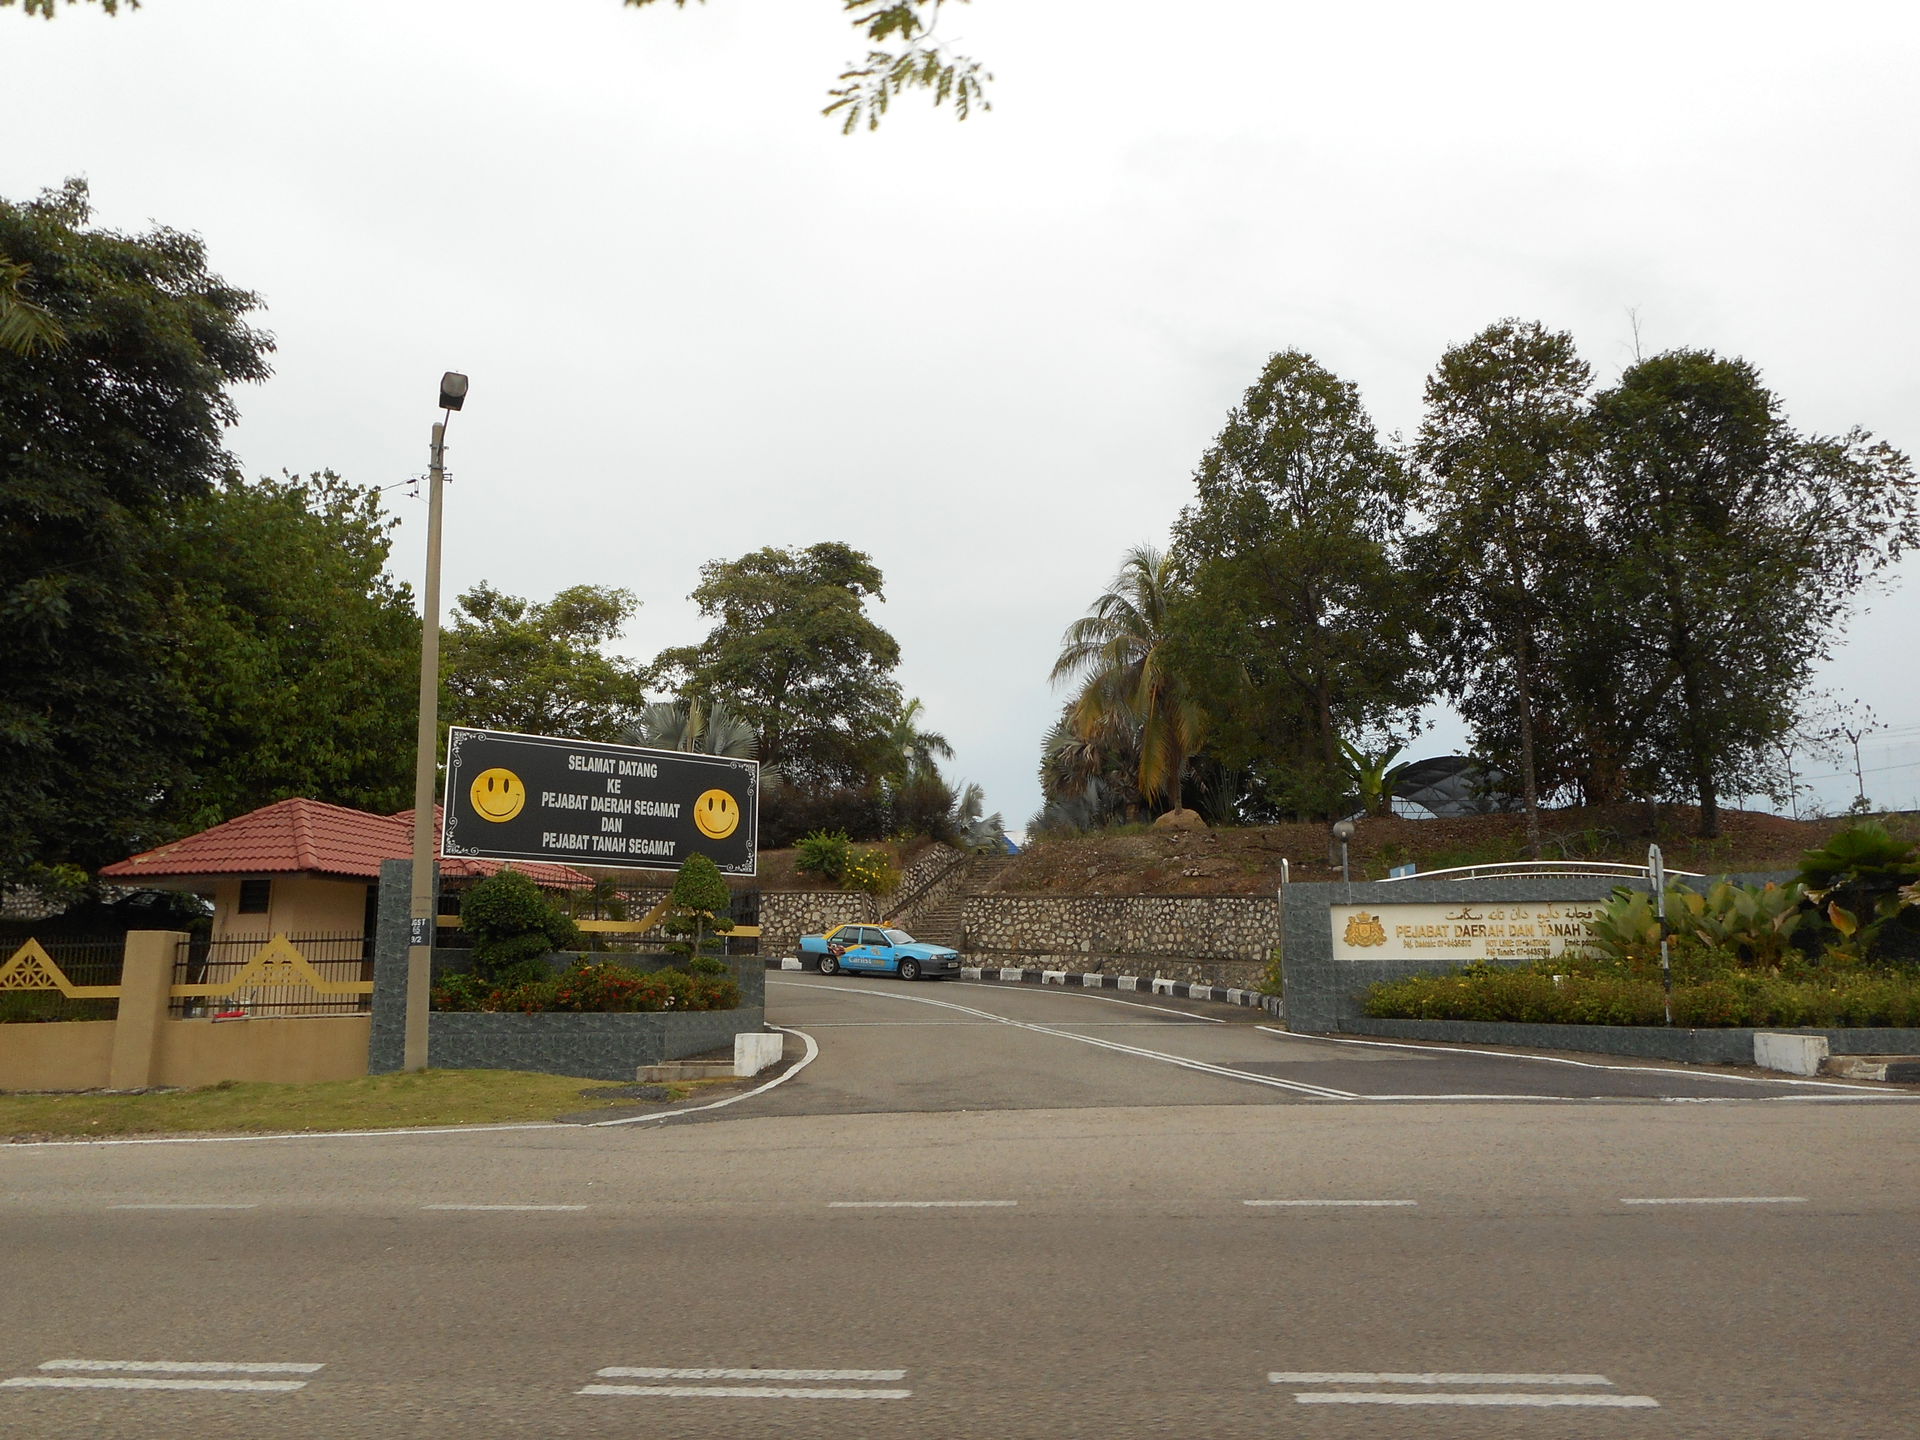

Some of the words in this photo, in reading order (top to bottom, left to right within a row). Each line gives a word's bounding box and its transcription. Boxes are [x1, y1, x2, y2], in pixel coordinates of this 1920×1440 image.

[568, 754, 616, 774] SELAMAT
[618, 760, 658, 778] DATANG
[607, 778, 621, 794] KE
[541, 791, 589, 810] PEJABAT
[590, 796, 632, 814] DAERAH
[634, 800, 681, 818] SEGAMAT
[601, 816, 622, 833] DAN
[542, 831, 590, 850] PEJABAT
[591, 835, 626, 853] TANAH
[628, 837, 676, 856] SEGAMAT
[1395, 924, 1449, 938] PEJABAT
[1454, 924, 1504, 938] DAERAH
[1508, 924, 1535, 937] DAN
[1539, 923, 1580, 937] TANAH
